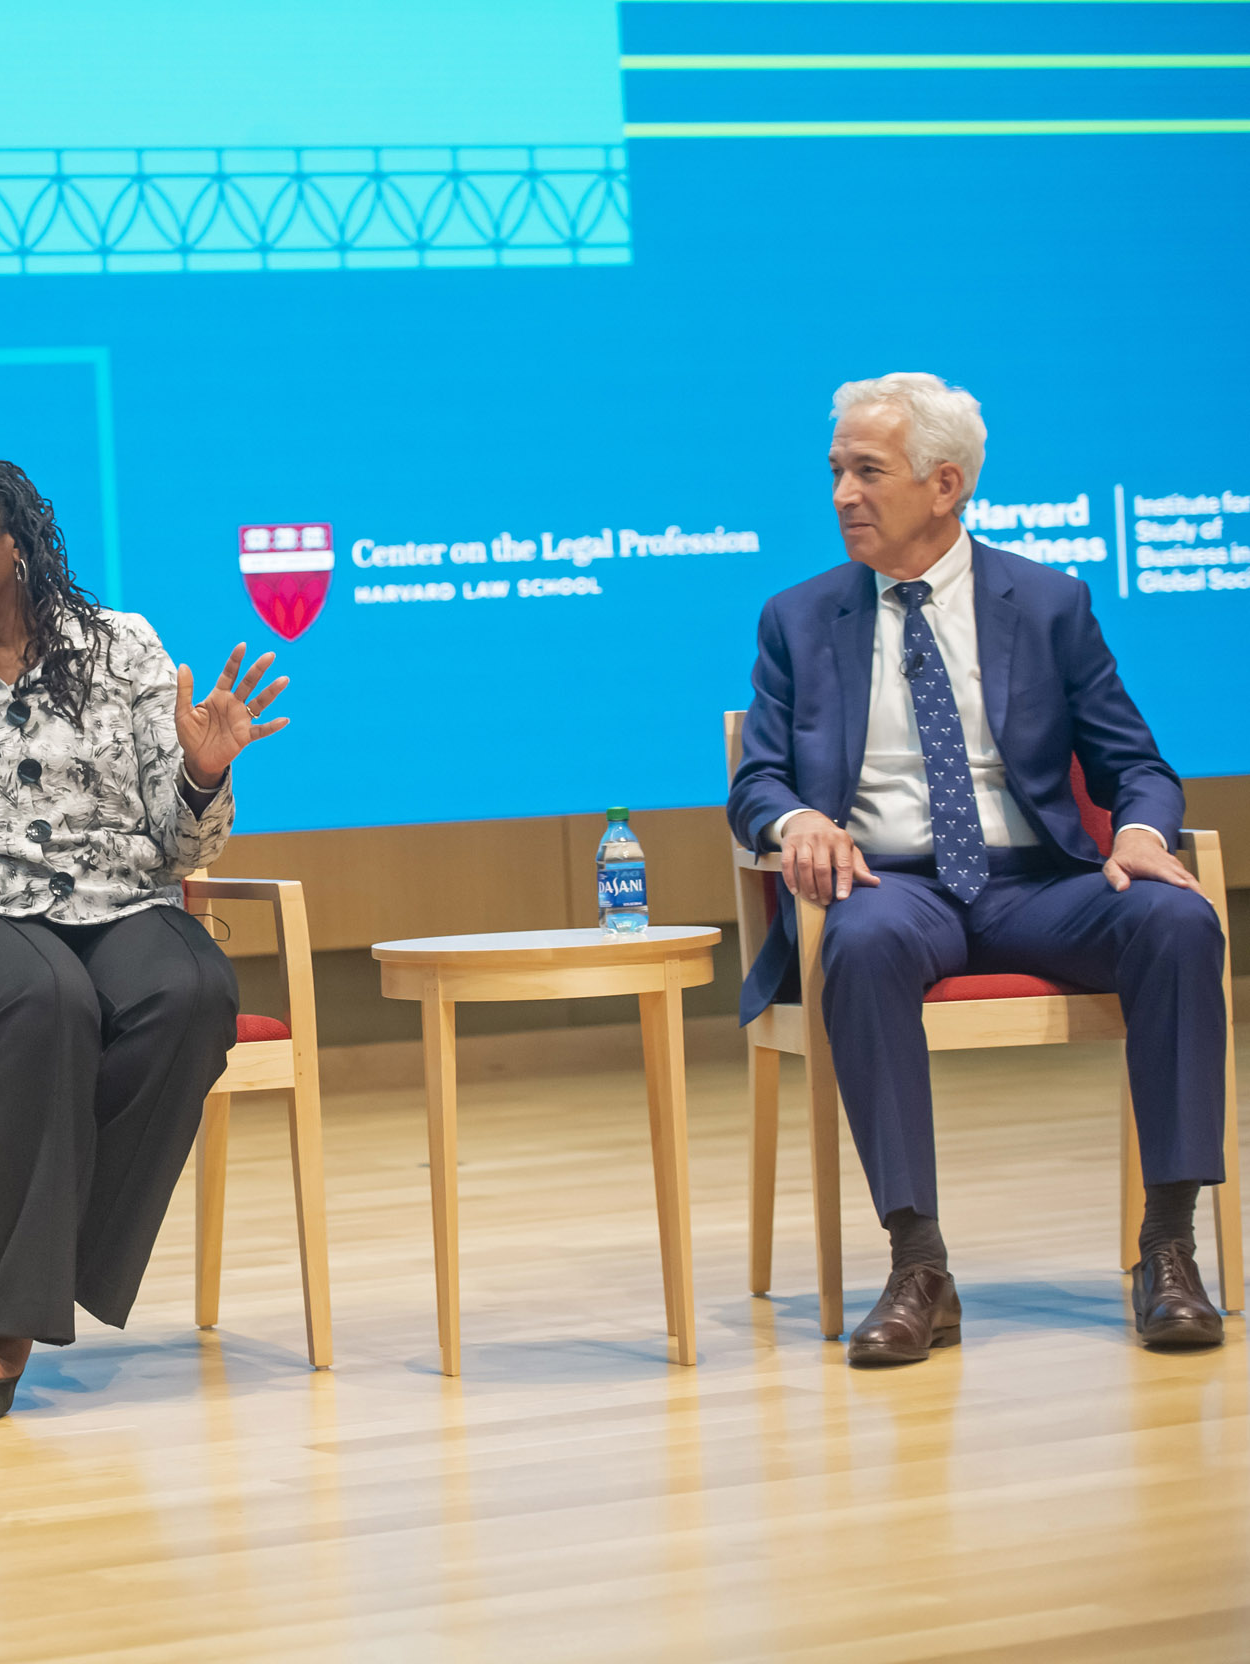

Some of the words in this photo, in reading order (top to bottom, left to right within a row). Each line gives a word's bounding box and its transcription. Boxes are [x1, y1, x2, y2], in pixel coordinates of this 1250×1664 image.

[965, 493, 1090, 530] Harvard
[1134, 493, 1220, 517] Institute
[1135, 517, 1198, 545] Study
[1199, 516, 1223, 540] of
[352, 539, 447, 567] Center
[450, 542, 488, 564] on
[492, 532, 536, 562] the
[541, 528, 614, 566] Legal
[619, 526, 760, 558] Profession
[1136, 544, 1229, 568] Business
[354, 583, 456, 604] HARVARD
[462, 580, 510, 600] LAW
[516, 577, 603, 598] SCHOOL
[1137, 567, 1207, 594] Global
[1207, 566, 1250, 591] Soc
[598, 877, 643, 897] DASANI
